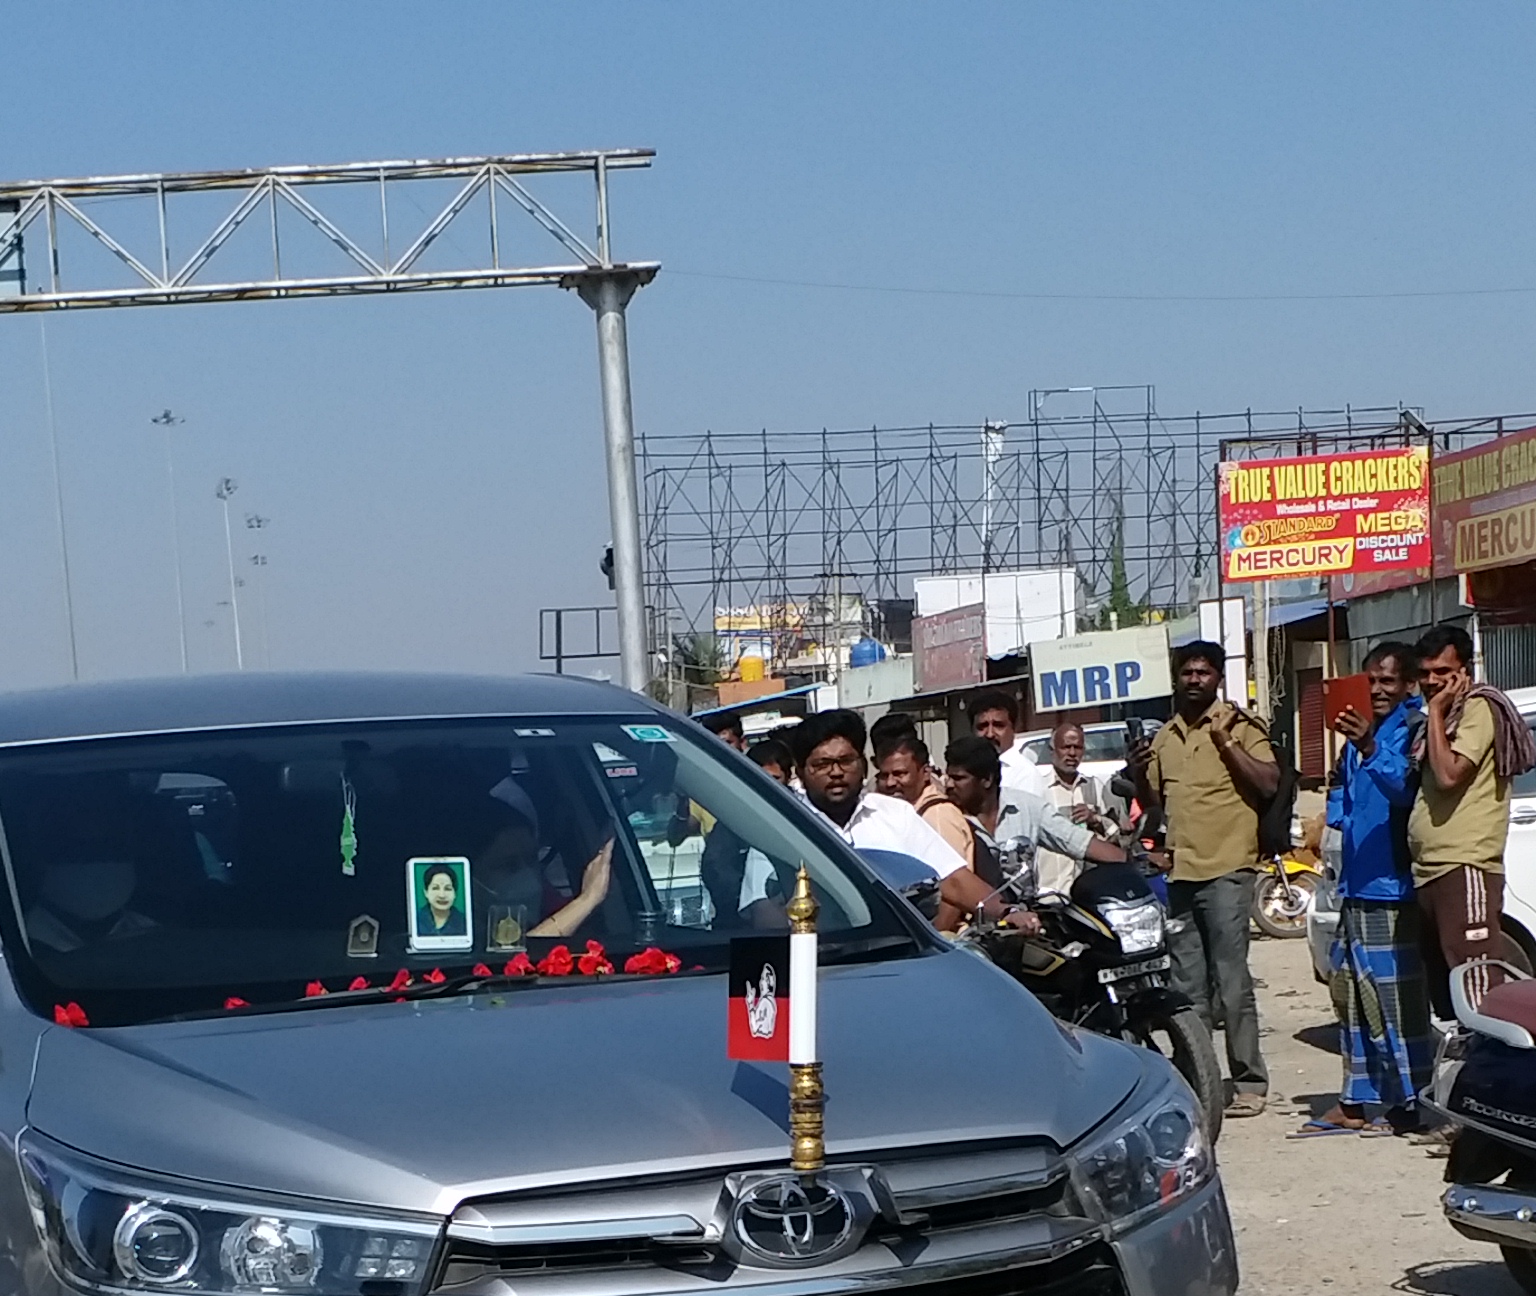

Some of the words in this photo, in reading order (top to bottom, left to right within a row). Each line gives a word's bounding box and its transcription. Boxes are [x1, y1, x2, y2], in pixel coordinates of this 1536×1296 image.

[1227, 467, 1272, 504] TRUE
[1274, 462, 1327, 500] VALUE
[1329, 456, 1422, 496] CRACKERS
[1433, 461, 1461, 506] TRUE
[1463, 450, 1500, 499] VALUE
[1276, 500, 1316, 515] Wholesale
[1326, 498, 1350, 511] Retail
[1355, 509, 1424, 534] MEGA
[1355, 533, 1424, 550] DISCOUNT
[1237, 542, 1350, 572] MERCURY
[1373, 549, 1408, 562] SALE
[1040, 661, 1142, 708] MRP
